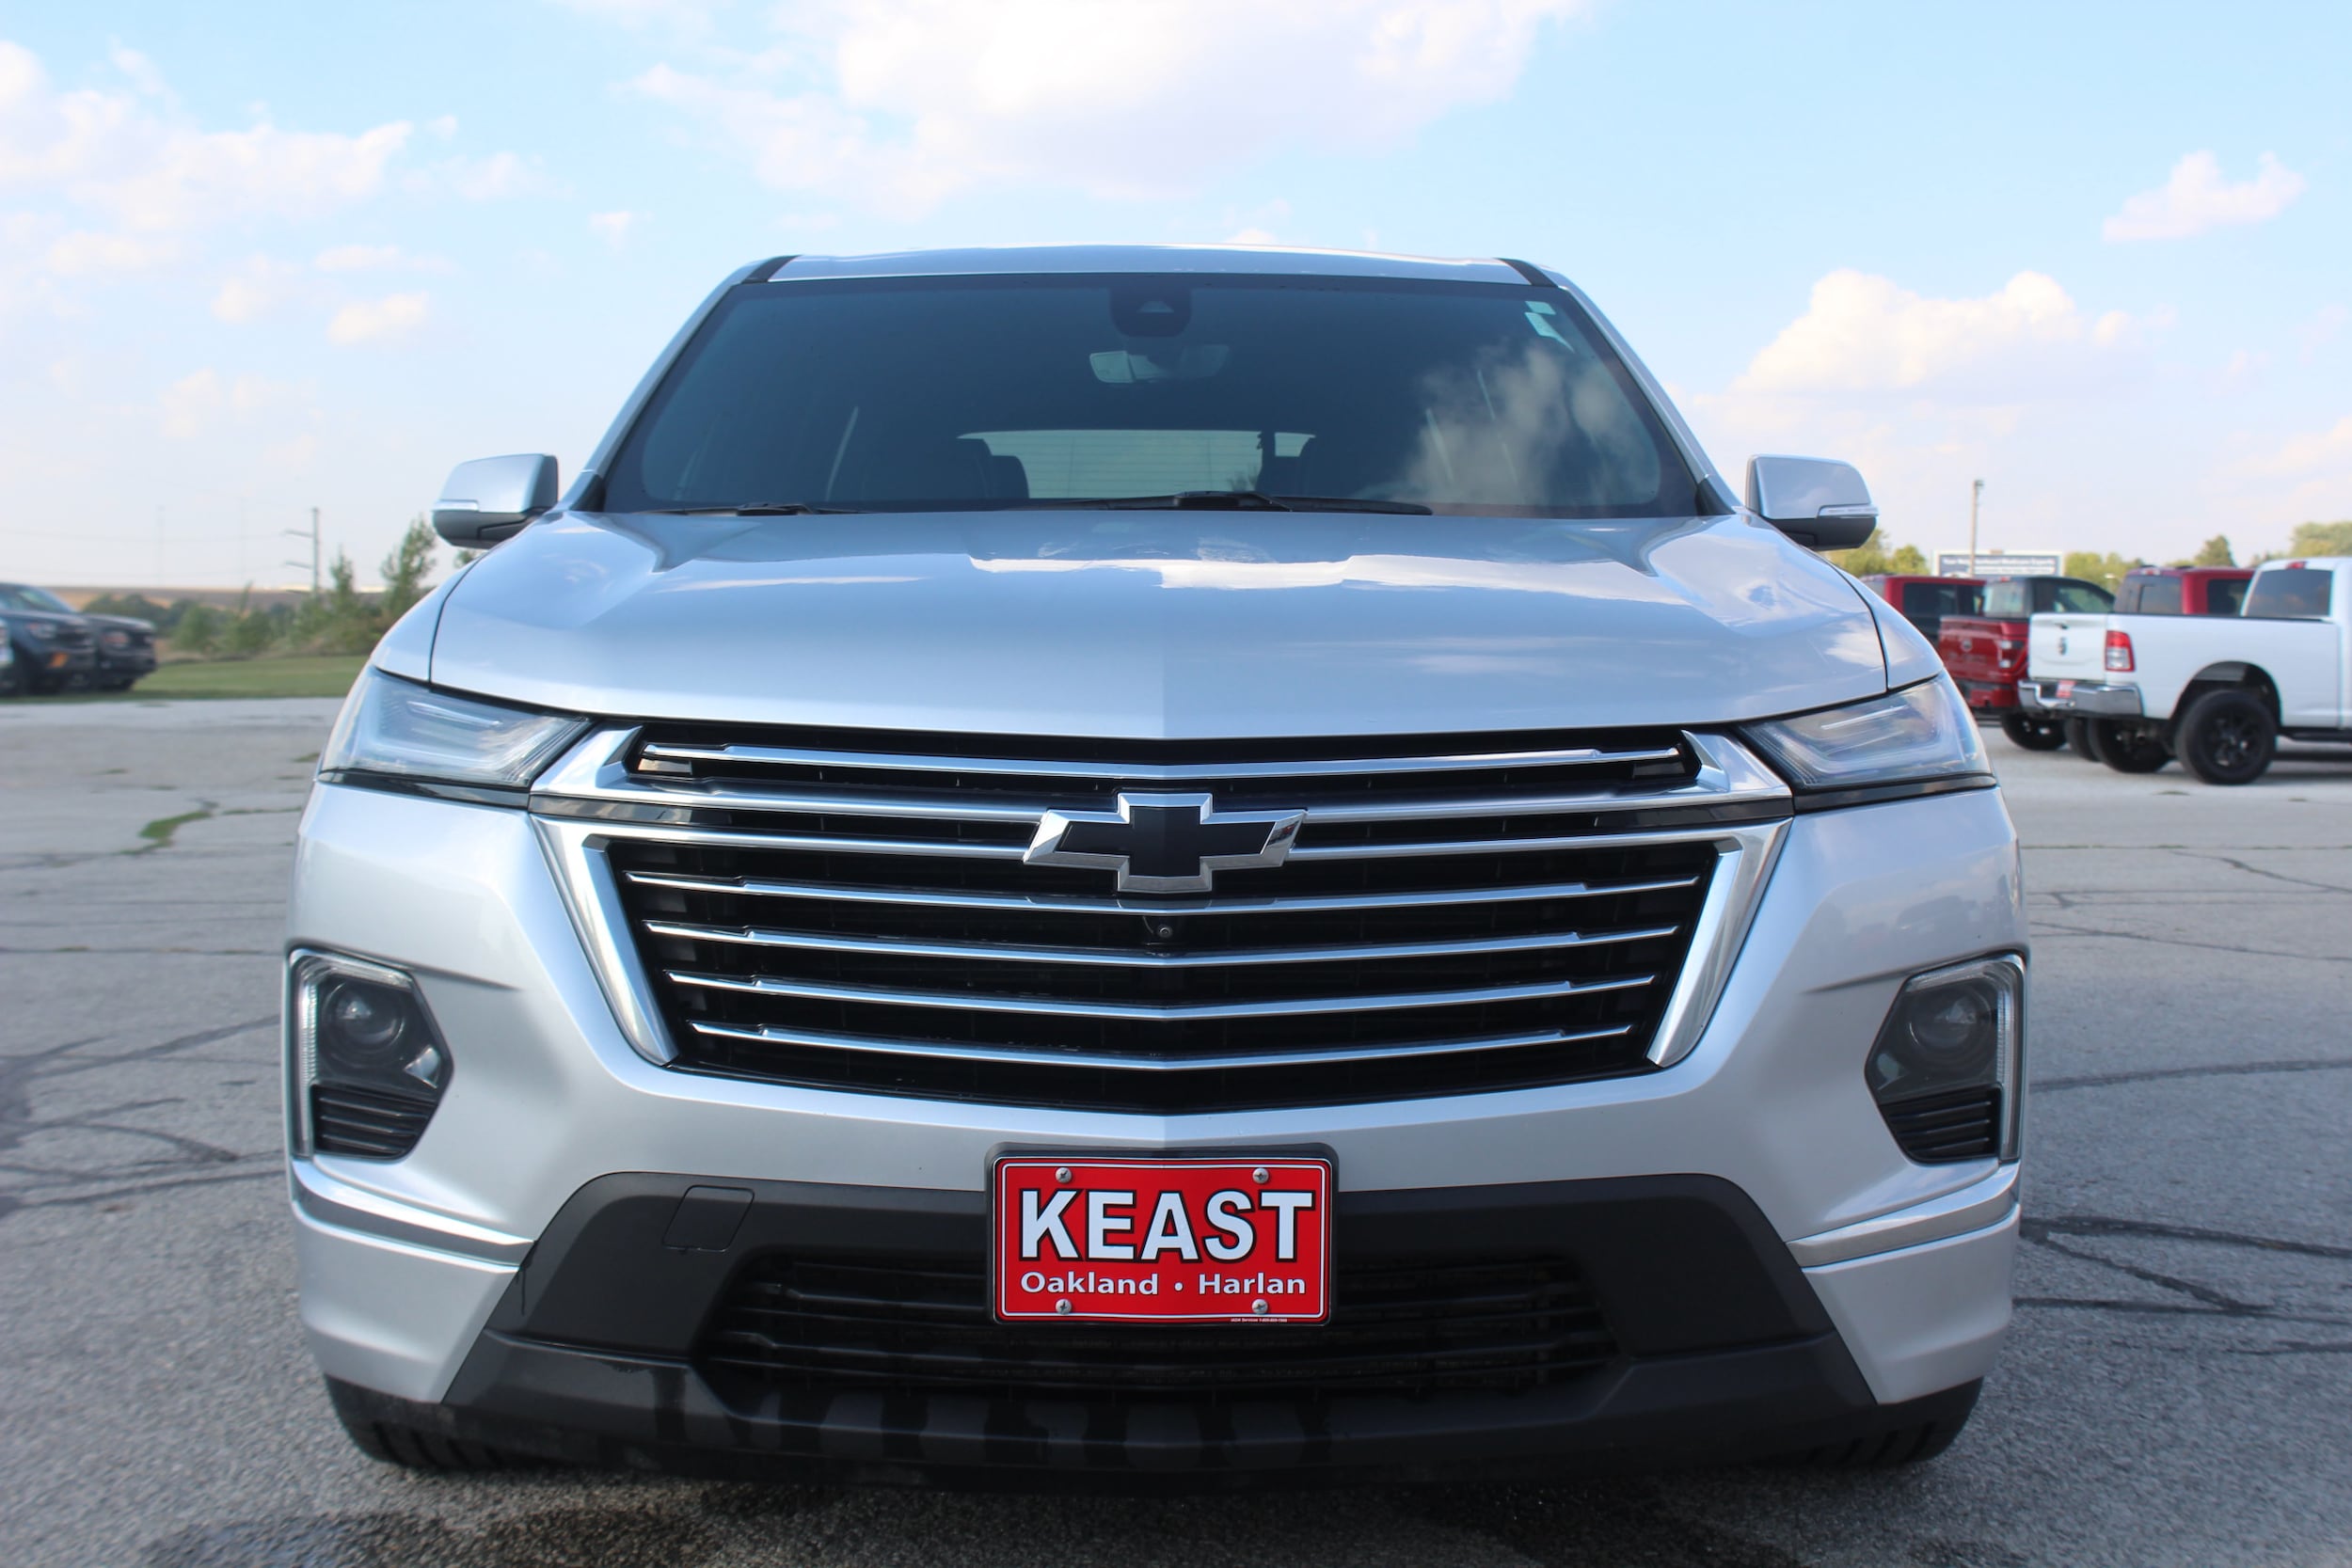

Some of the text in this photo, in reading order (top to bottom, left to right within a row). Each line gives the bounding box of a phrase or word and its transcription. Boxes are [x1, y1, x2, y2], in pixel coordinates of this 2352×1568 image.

[1019, 1189, 1315, 1262] KEAST
[1020, 1271, 1306, 1295] Oakland Harlan
